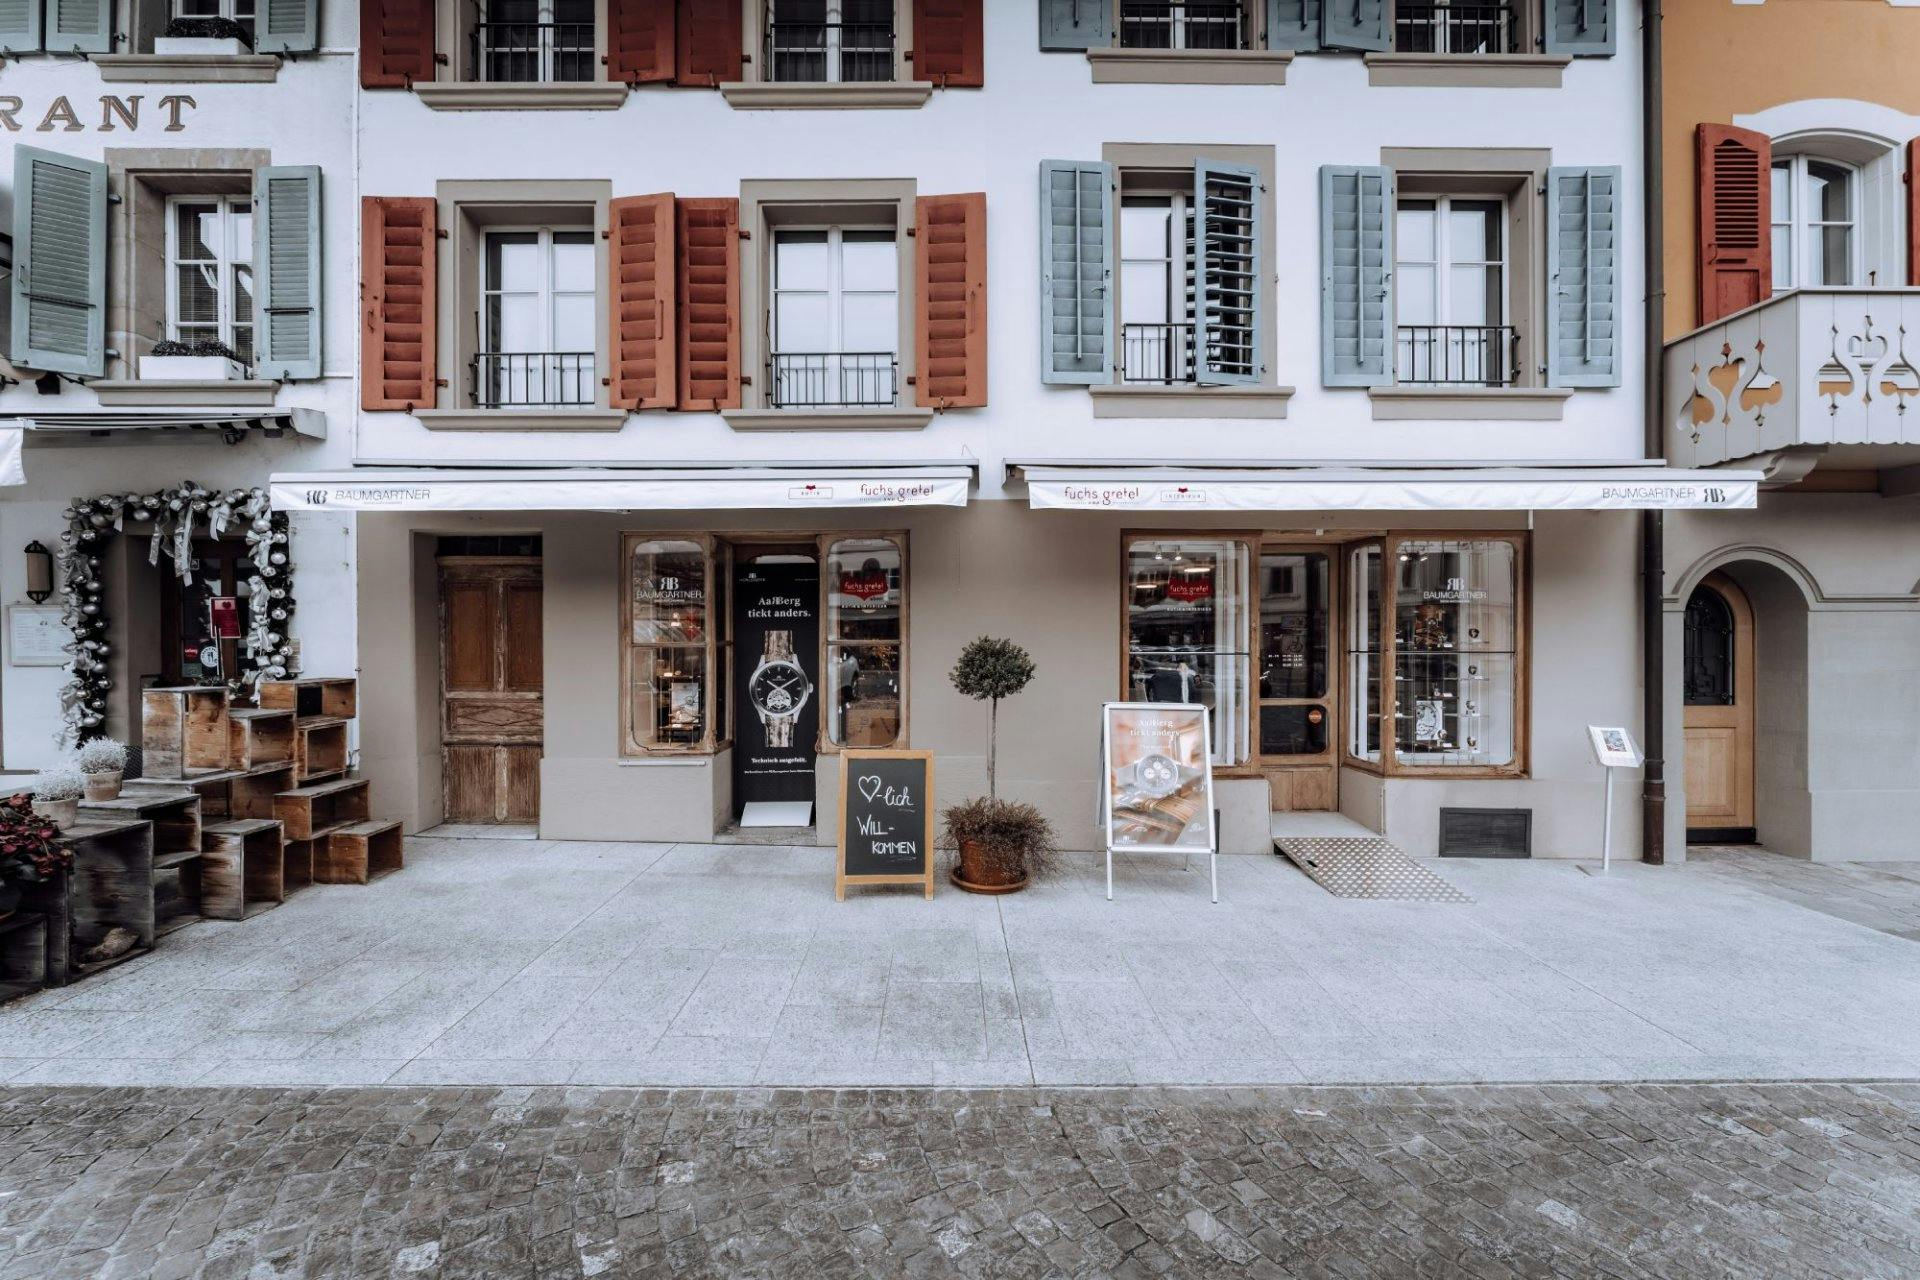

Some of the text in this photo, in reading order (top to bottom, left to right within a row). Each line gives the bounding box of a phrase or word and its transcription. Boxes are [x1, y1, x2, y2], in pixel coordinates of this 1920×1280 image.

[335, 489, 431, 500] BAUMGARTNER
[859, 483, 935, 502] fuchs gretel
[1064, 486, 1139, 506] fuchs gretel
[1602, 487, 1696, 499] BAUMGARTNER
[636, 590, 702, 599] BAUMGARTNER
[1423, 591, 1487, 599] BAUMGARTNER
[748, 608, 811, 618] tickt anders.
[872, 841, 917, 855] KOMMEN
